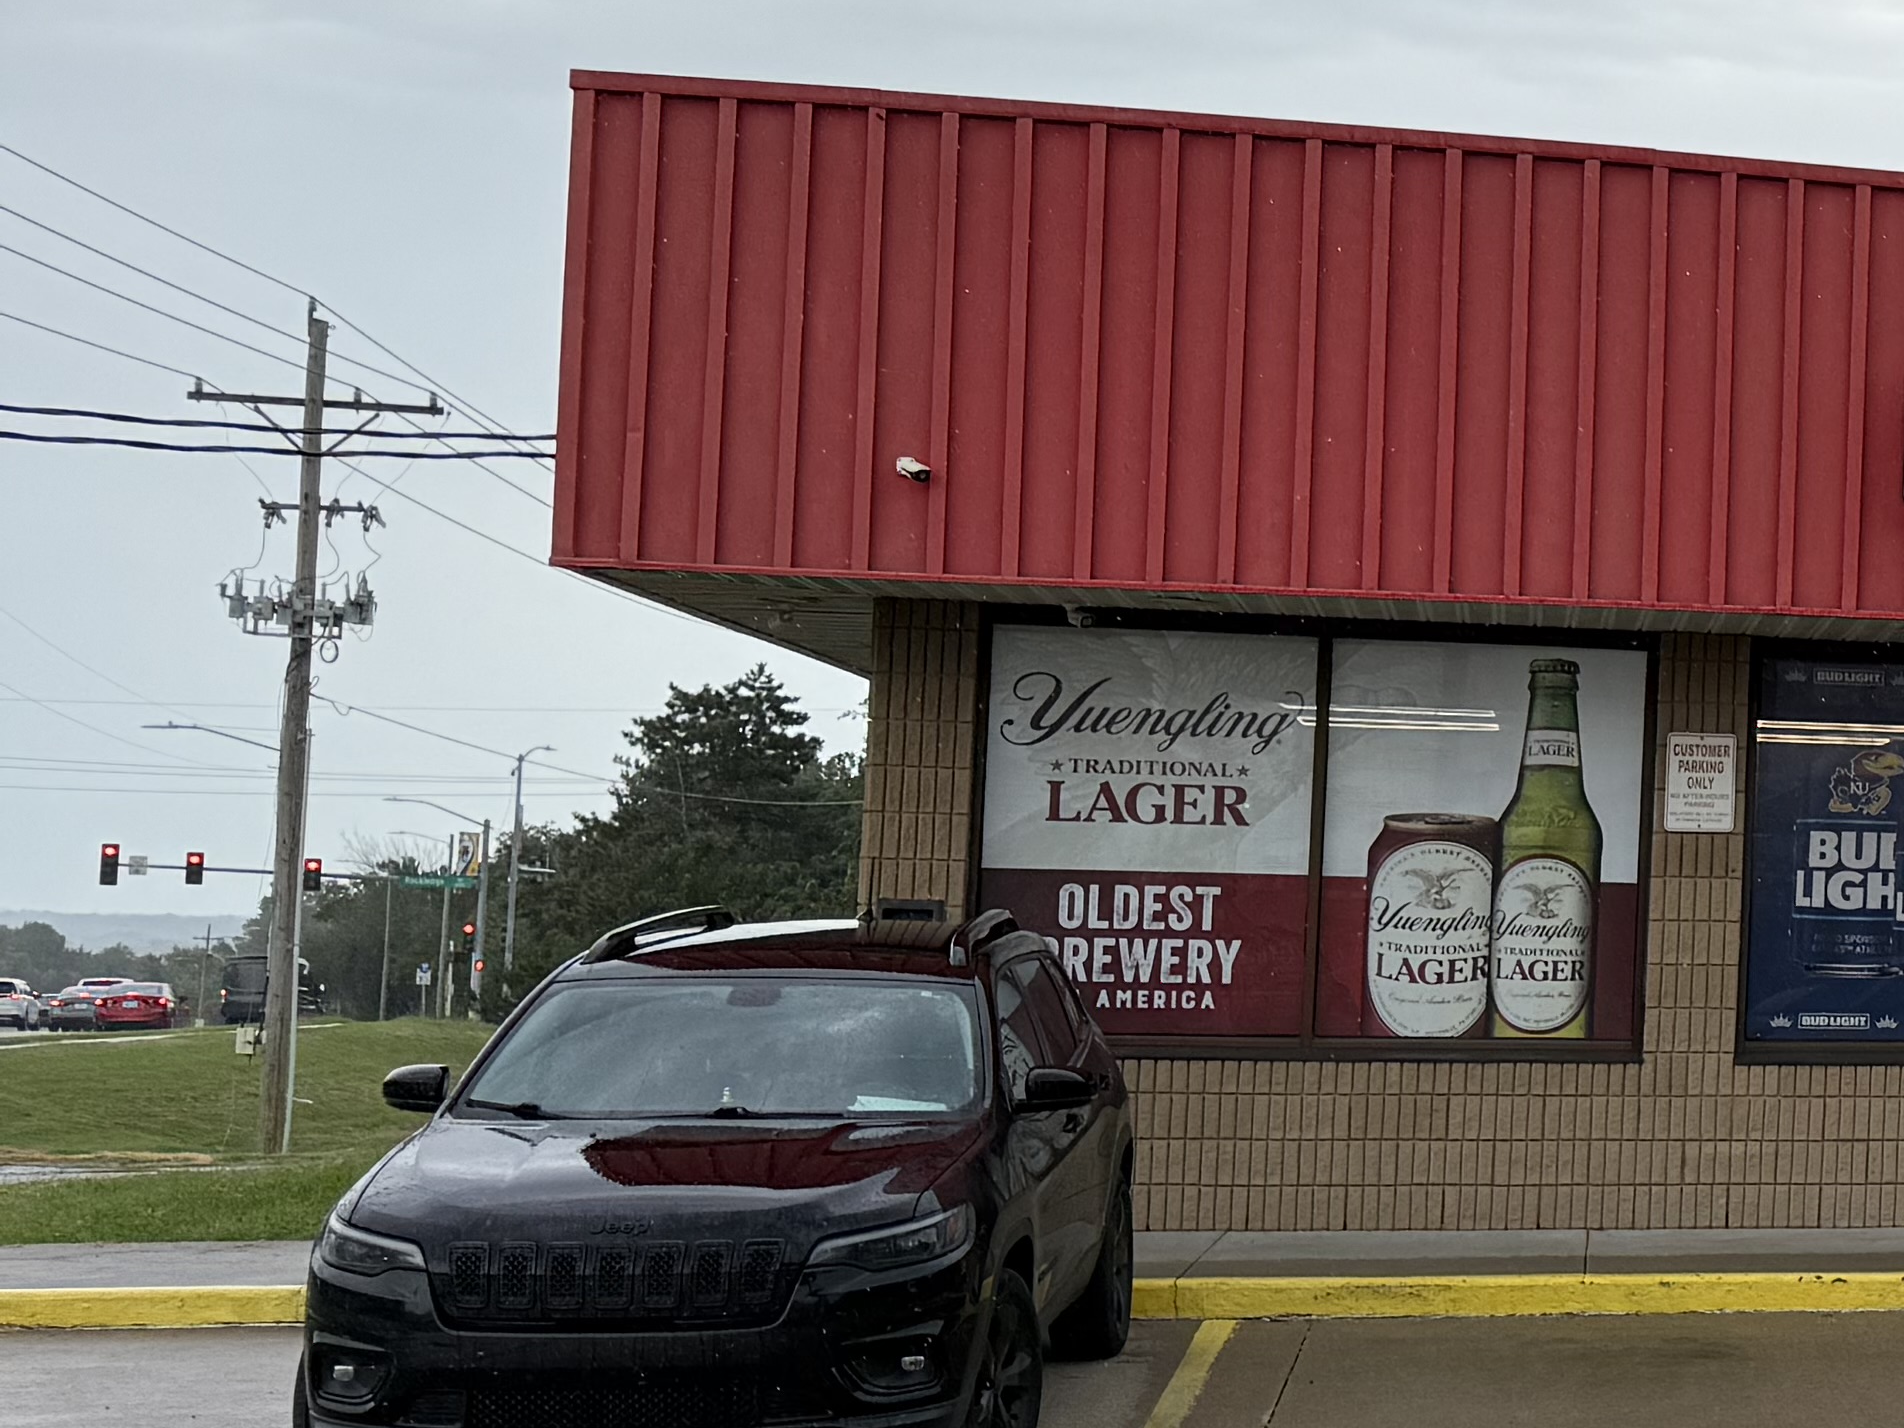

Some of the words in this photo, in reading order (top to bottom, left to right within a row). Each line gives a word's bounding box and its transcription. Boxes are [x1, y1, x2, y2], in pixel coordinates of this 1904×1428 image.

[1000, 671, 1305, 756] Yuengling
[1528, 744, 1576, 759] LAGER
[1673, 743, 1731, 759] CUSTOMER
[1068, 757, 1234, 779] TRADITIONAL
[1678, 759, 1725, 774] PARKING
[1687, 776, 1715, 790] ONLY
[1045, 780, 1250, 827] LAGER
[1795, 869, 1895, 910] LIGH
[1058, 883, 1222, 932] OLDEST
[1491, 909, 1591, 945] Yuengling
[1386, 940, 1484, 956] TRADITIONAL
[1504, 946, 1580, 957] TRADITIONAL
[1375, 951, 1488, 986] LAGER
[1495, 958, 1585, 983] LAGER
[1096, 989, 1216, 1010] AMERICA
[588, 1214, 651, 1237] Jeep
